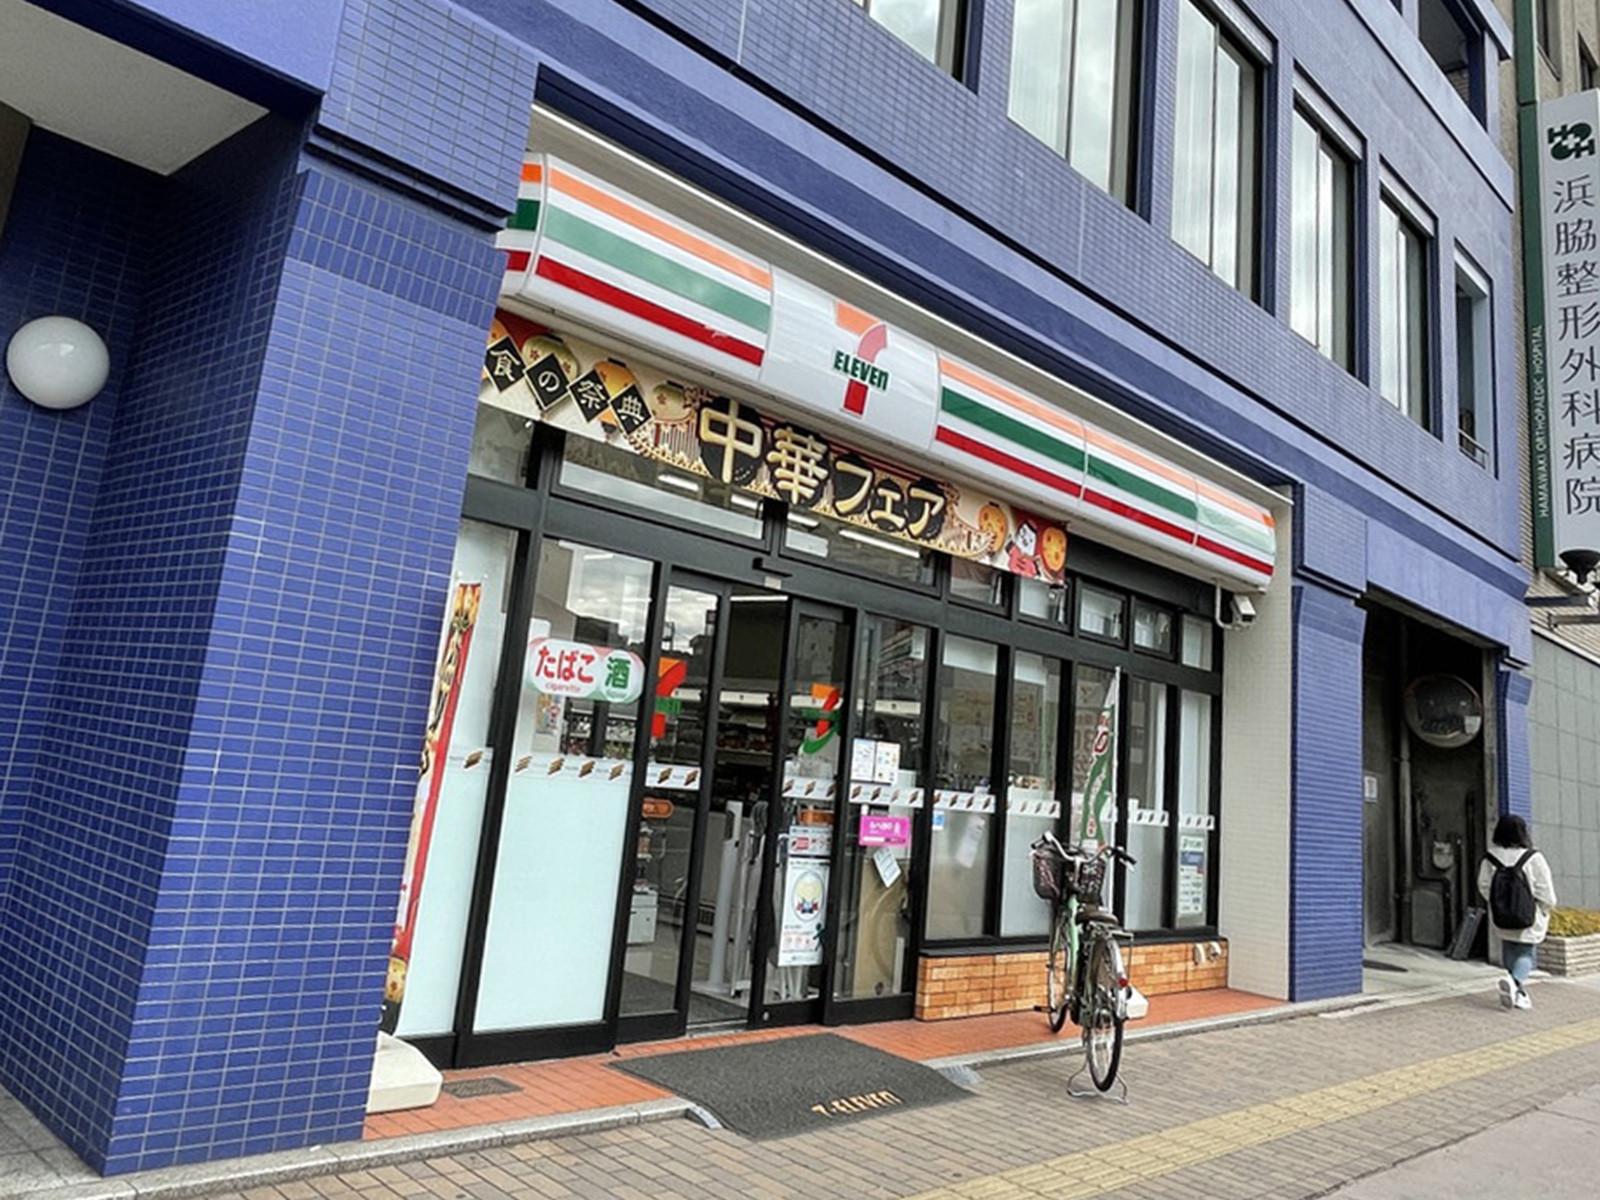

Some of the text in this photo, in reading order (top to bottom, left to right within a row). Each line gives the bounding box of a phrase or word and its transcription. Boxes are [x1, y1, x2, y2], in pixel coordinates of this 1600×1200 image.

[490, 349, 645, 424] 食の祭典
[1553, 174, 1600, 514] 浜脇整形外科病院
[700, 399, 945, 537] 中華フェア
[1532, 325, 1548, 518] HAMAWAKI ORTHOPAEDIC HOSPITAL
[535, 646, 595, 683] たばこ
[605, 657, 631, 689] 酒
